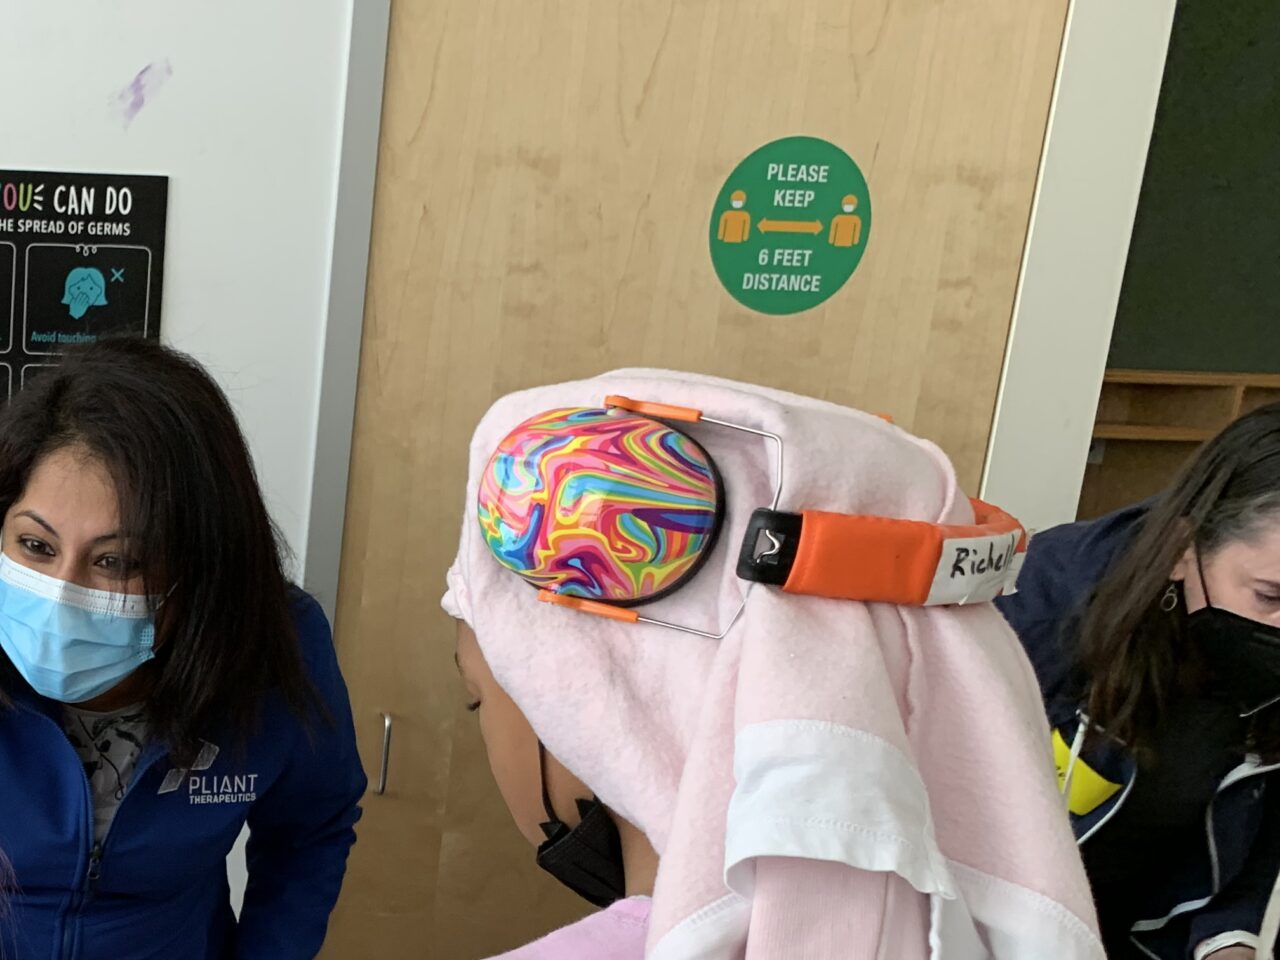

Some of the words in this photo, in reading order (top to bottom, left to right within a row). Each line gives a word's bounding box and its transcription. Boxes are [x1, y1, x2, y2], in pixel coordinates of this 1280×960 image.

[767, 163, 829, 183] PLEASE
[53, 185, 95, 215] CAN
[105, 187, 132, 216] DO
[773, 189, 815, 207] KEEP
[17, 219, 65, 234] SPREAD
[68, 221, 85, 235] OF
[87, 221, 131, 236] GERMS
[758, 249, 768, 265] 6
[773, 249, 813, 266] FEET
[742, 273, 821, 292] DISTANCE
[31, 331, 56, 343] Avoid
[189, 774, 258, 794] PLIANT
[189, 792, 256, 805] THERAPEUTICS
